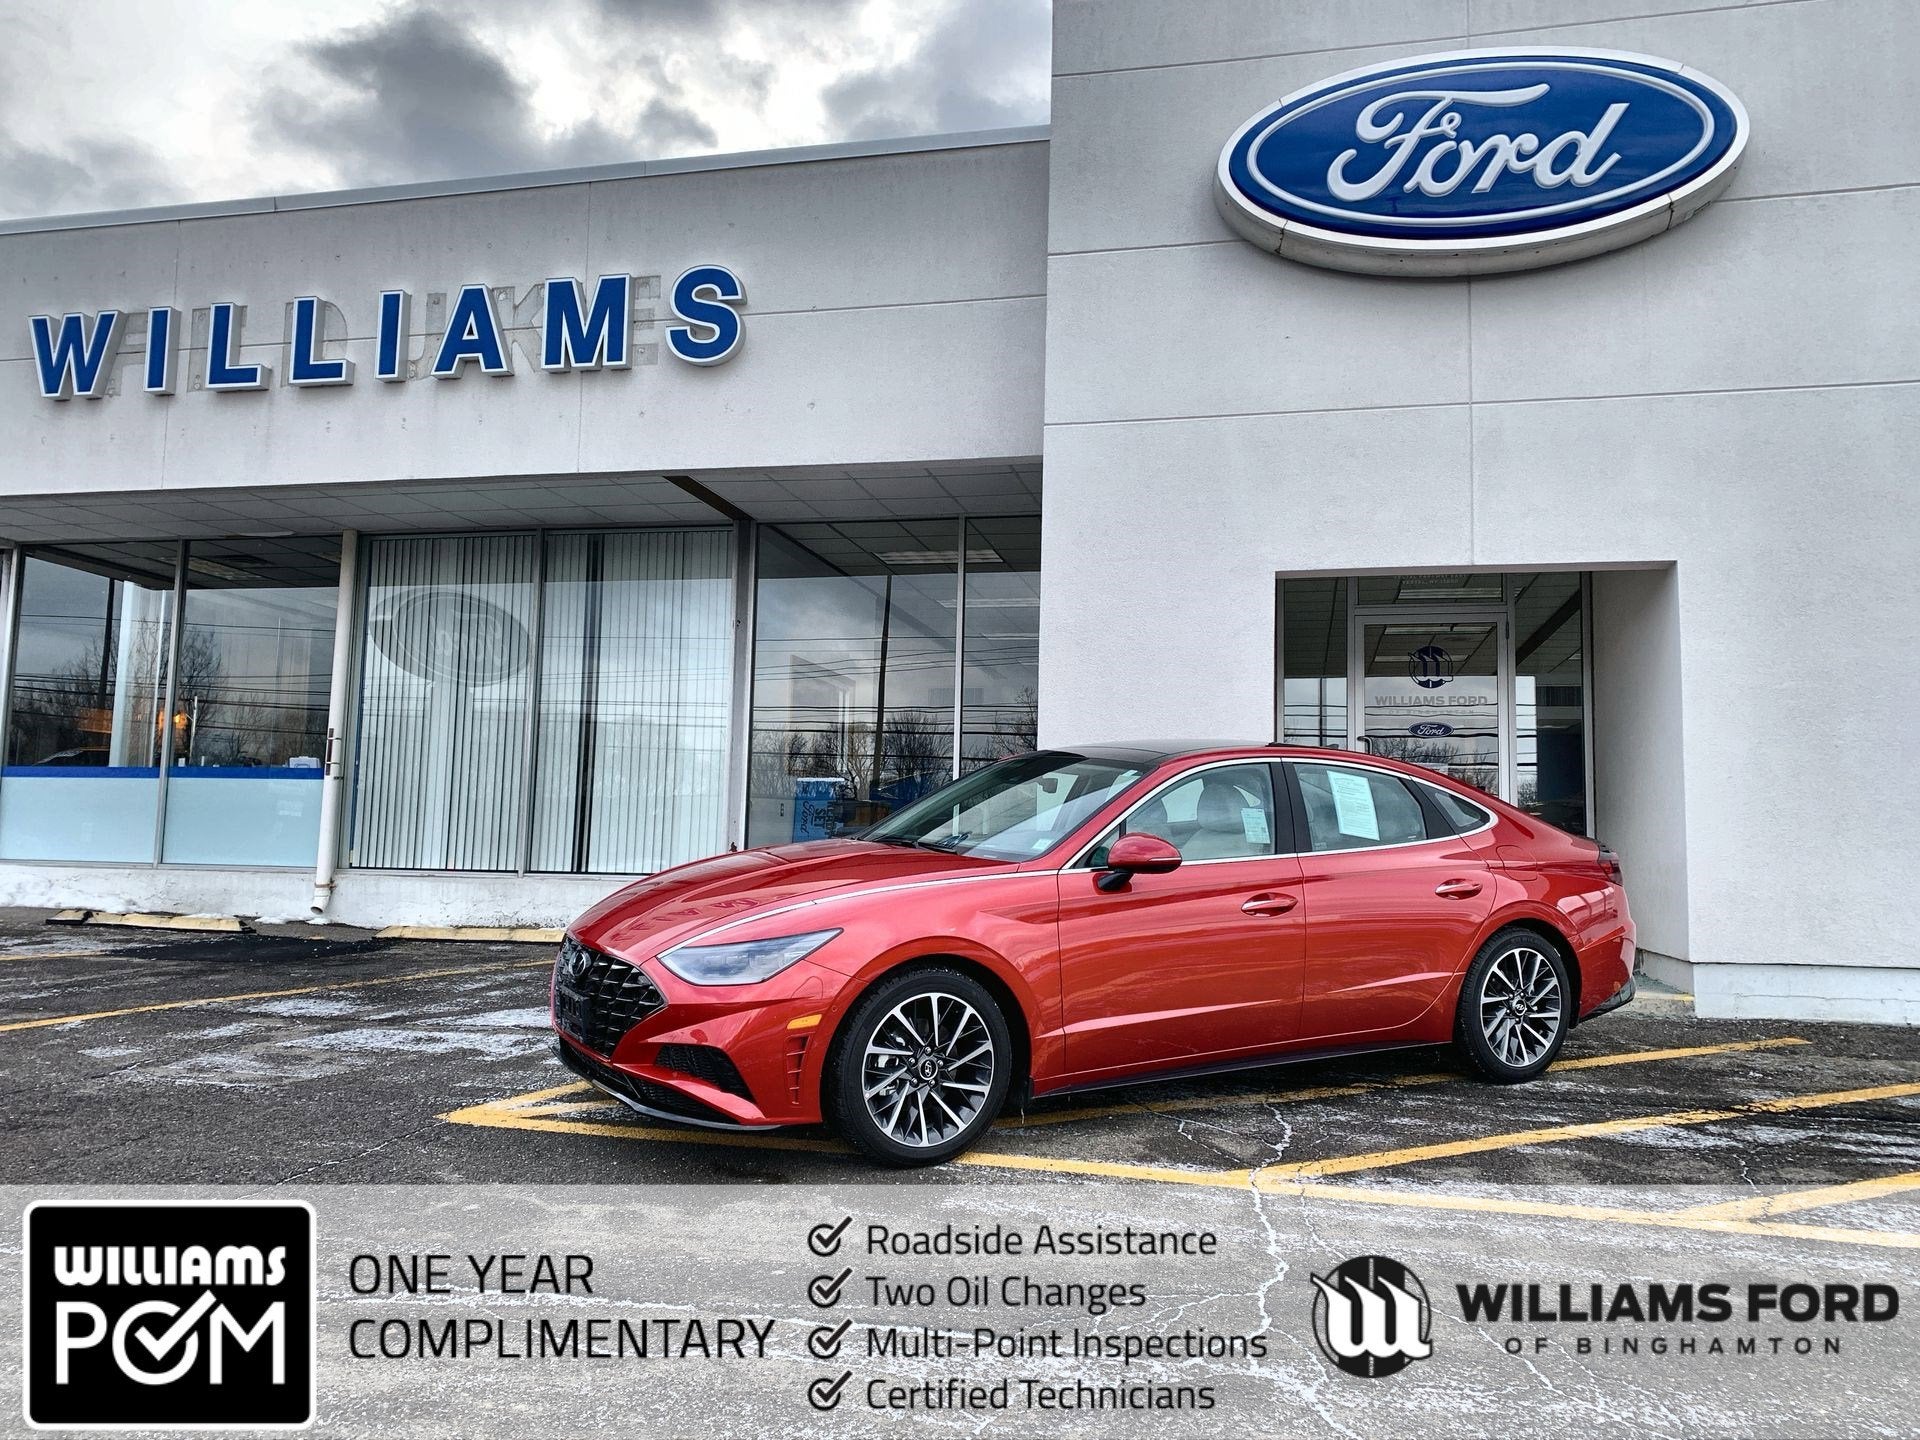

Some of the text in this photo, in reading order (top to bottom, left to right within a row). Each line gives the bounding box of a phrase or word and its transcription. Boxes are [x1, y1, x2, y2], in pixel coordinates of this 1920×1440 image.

[1326, 82, 1630, 202] Ford
[28, 264, 748, 400] WILLIAMS
[1375, 695, 1488, 705] WILLIAMS FORD
[1417, 724, 1445, 736] Ford
[801, 801, 815, 834] Ford
[814, 808, 826, 828] SET
